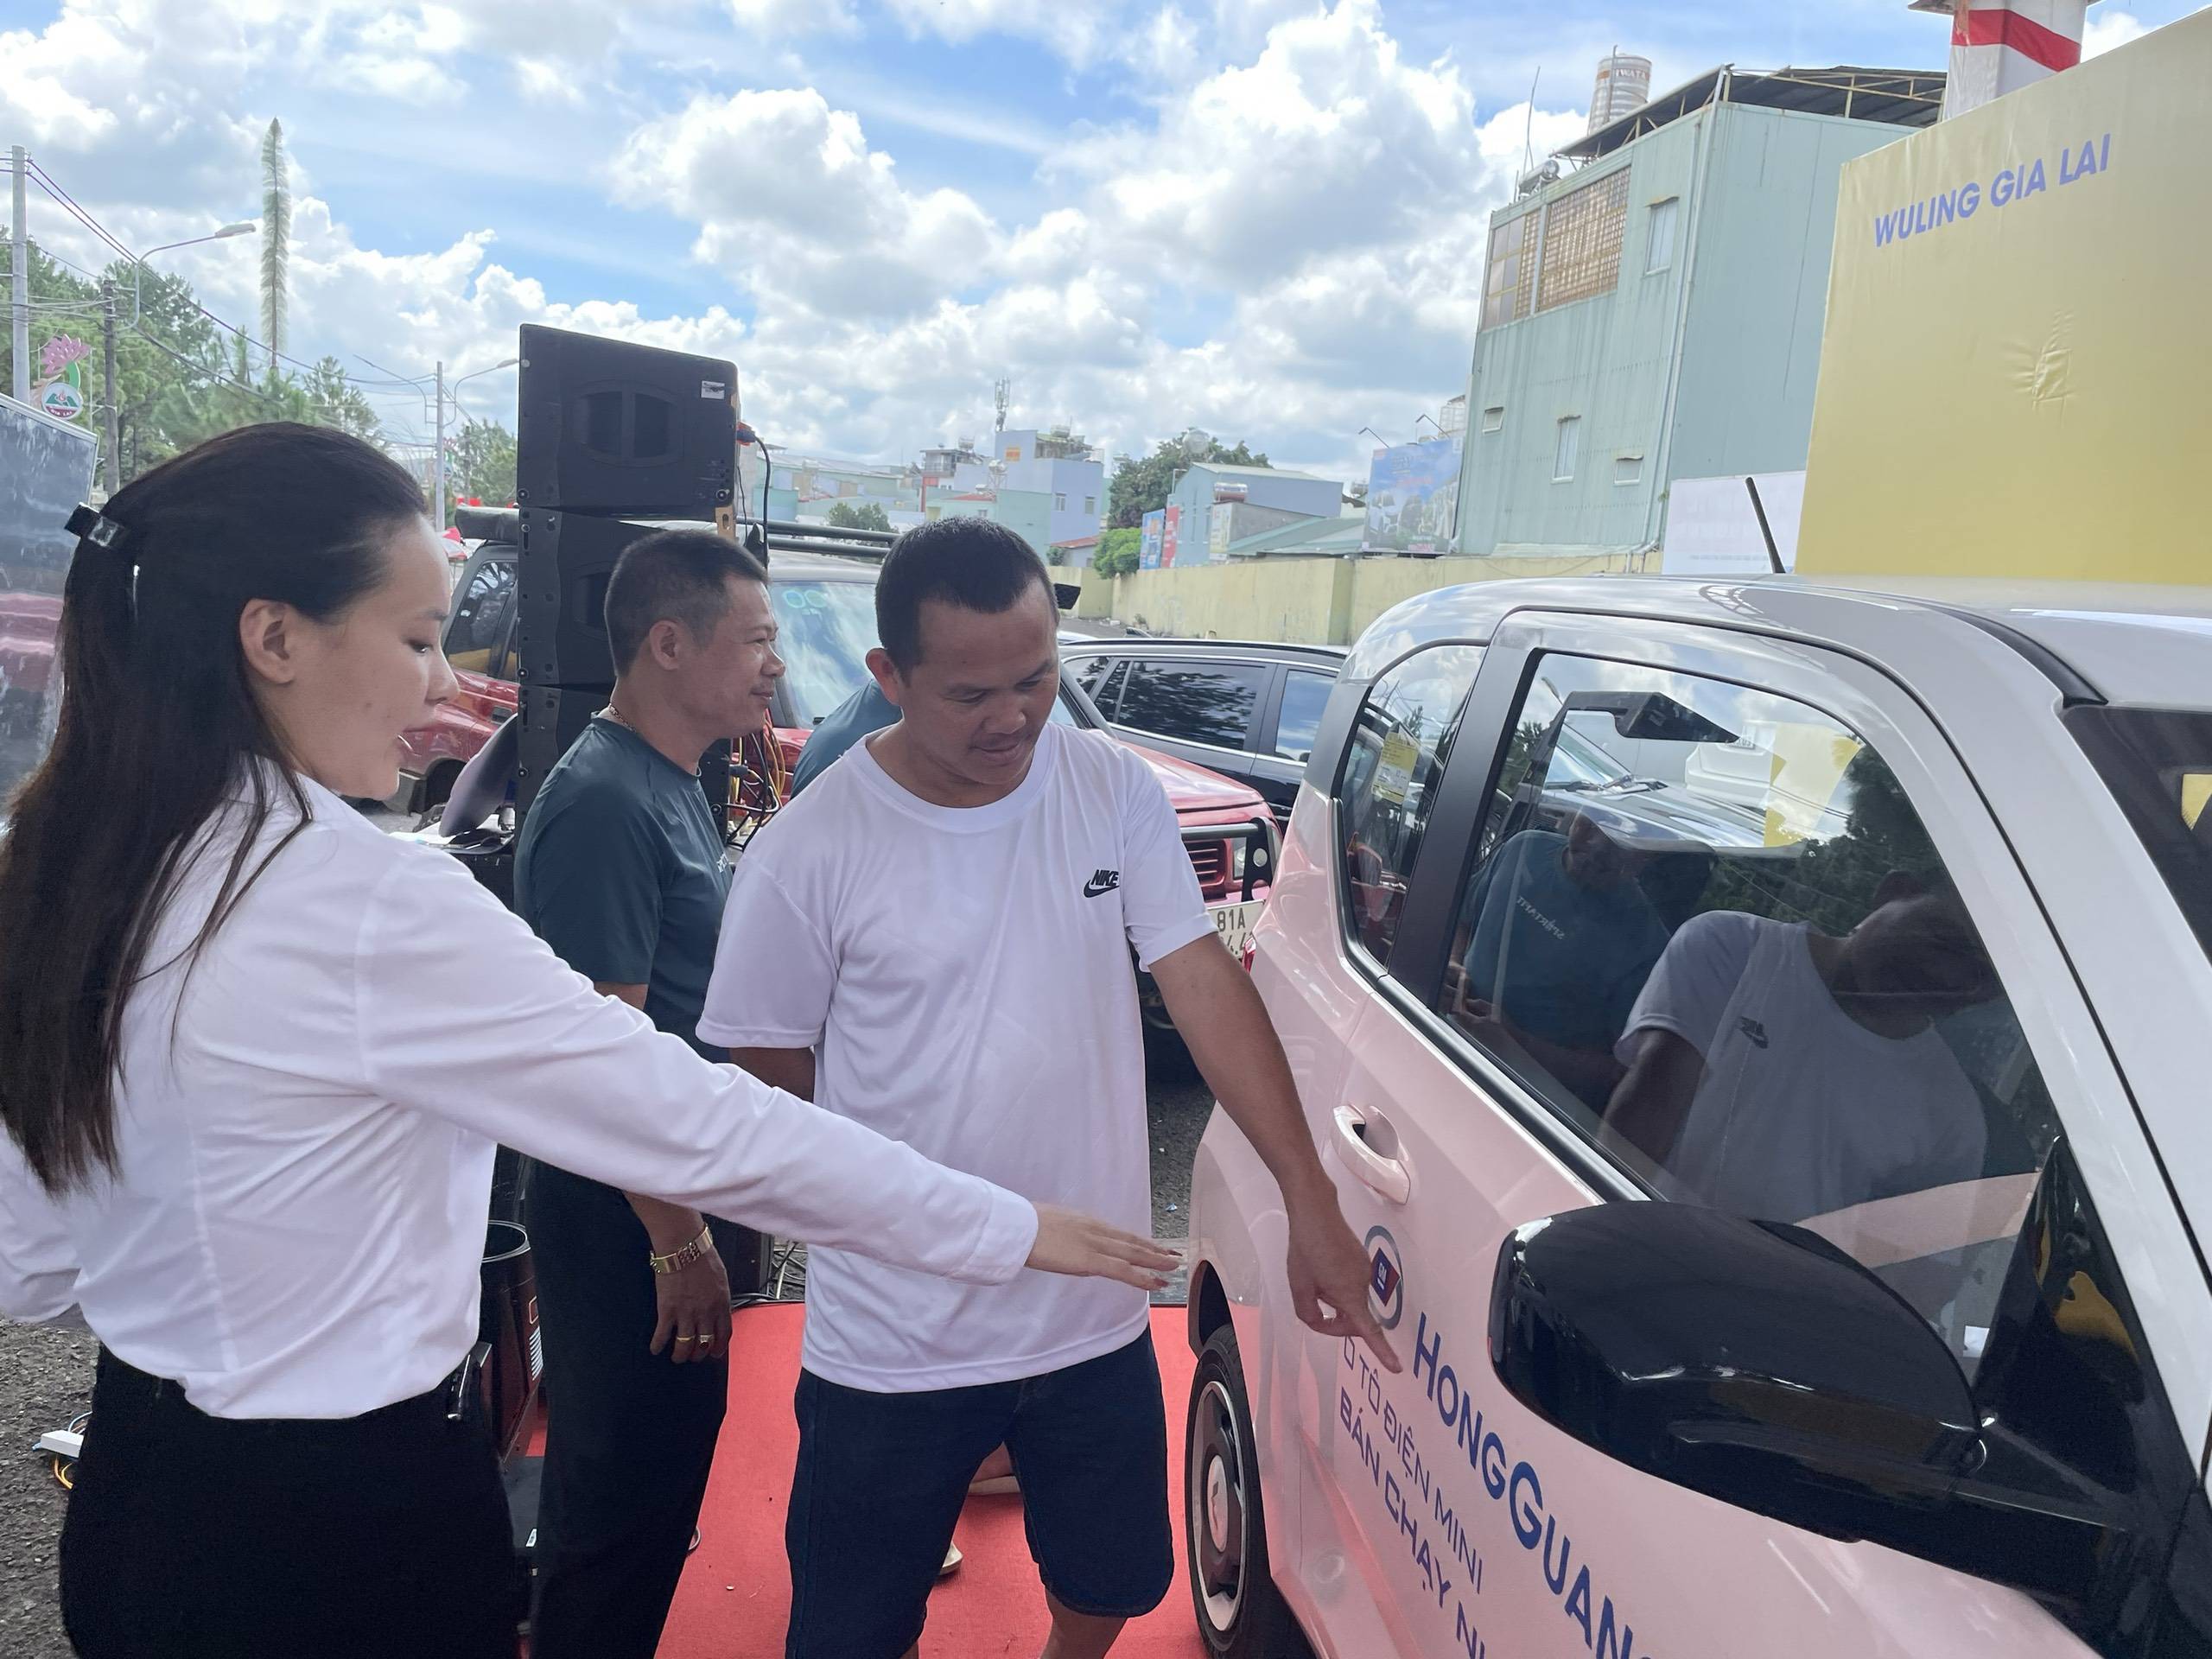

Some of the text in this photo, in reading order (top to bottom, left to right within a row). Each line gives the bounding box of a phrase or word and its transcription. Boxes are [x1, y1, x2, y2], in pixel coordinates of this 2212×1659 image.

[1874, 133, 2111, 248] WULING GIA LAI
[1090, 868, 1119, 887] NIKE
[1217, 907, 1246, 932] 81A
[1340, 1385, 1381, 1487] BÁN
[1384, 1470, 1452, 1609] CHẠY
[1359, 1353, 1381, 1416] TÔ
[1383, 1399, 1430, 1504] ĐIỆN
[1434, 1486, 1483, 1595] MINI
[1413, 1310, 1652, 1659] HONGGUAN
